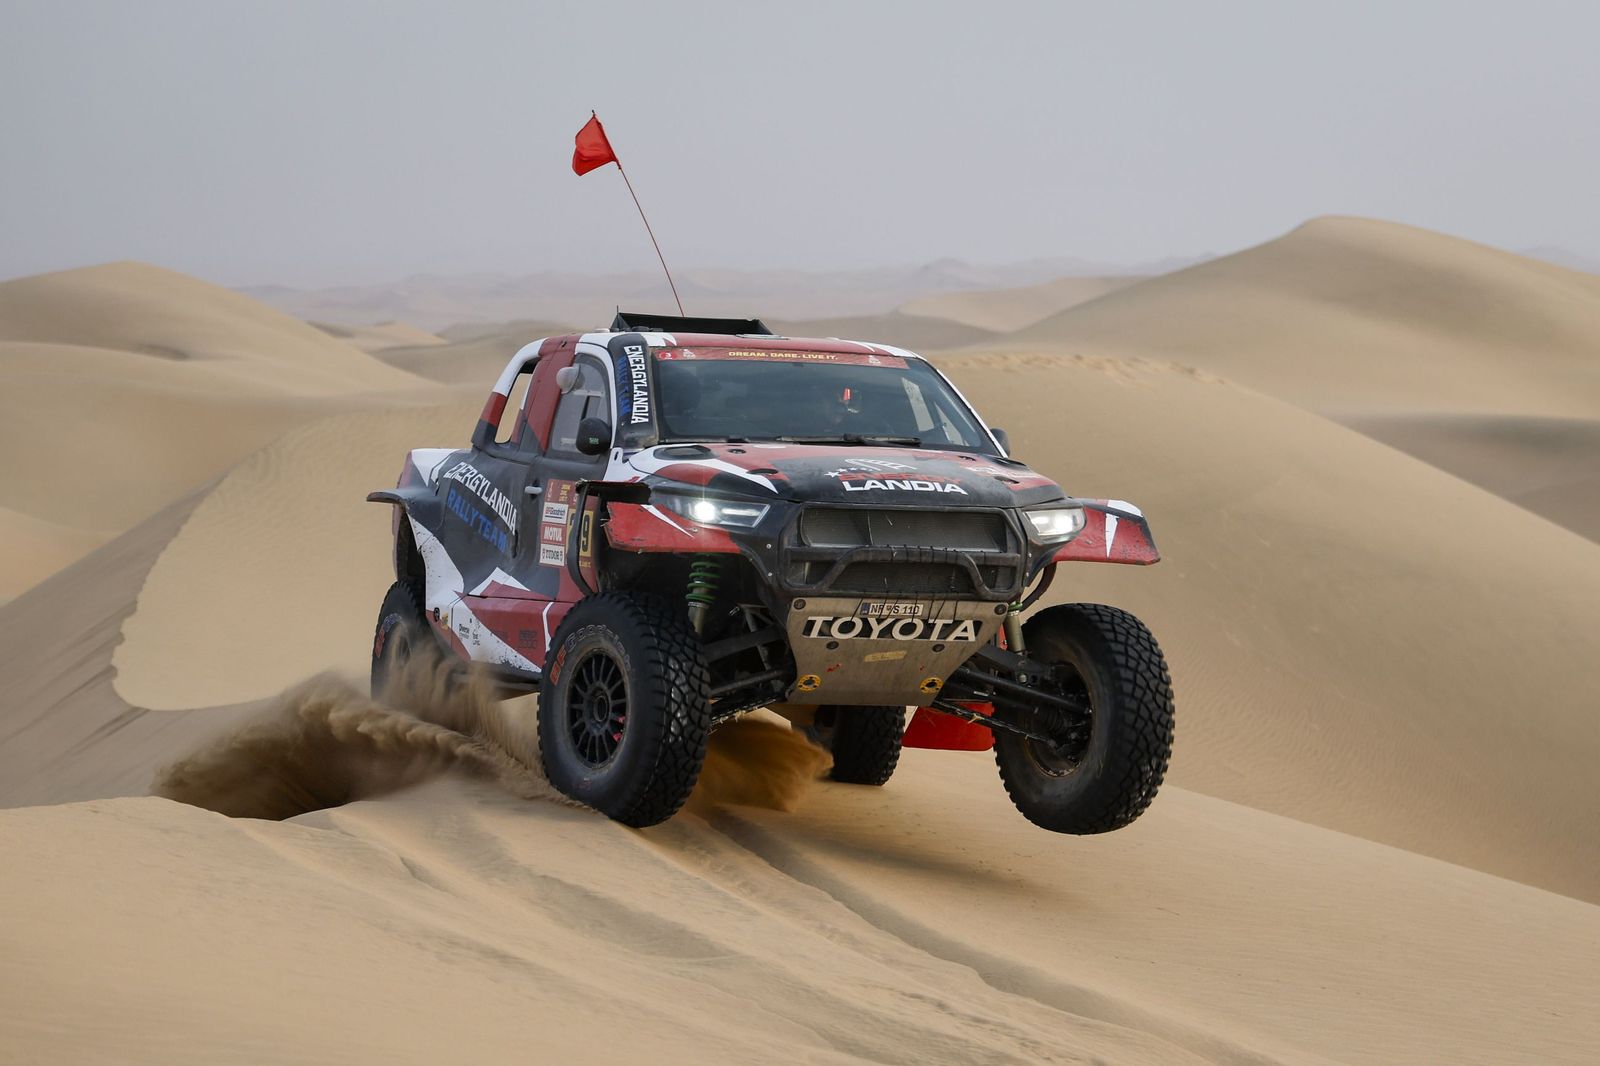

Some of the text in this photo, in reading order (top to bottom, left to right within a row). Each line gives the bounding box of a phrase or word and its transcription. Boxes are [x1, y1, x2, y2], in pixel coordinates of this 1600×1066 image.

[624, 345, 649, 424] ENERGYLANDIA
[443, 461, 517, 535] ENERGYLANDIA
[842, 480, 968, 496] LANDIA
[447, 488, 508, 553] RALLY TEAM
[543, 526, 563, 542] MOTUL
[807, 616, 976, 642] TOYOTA
